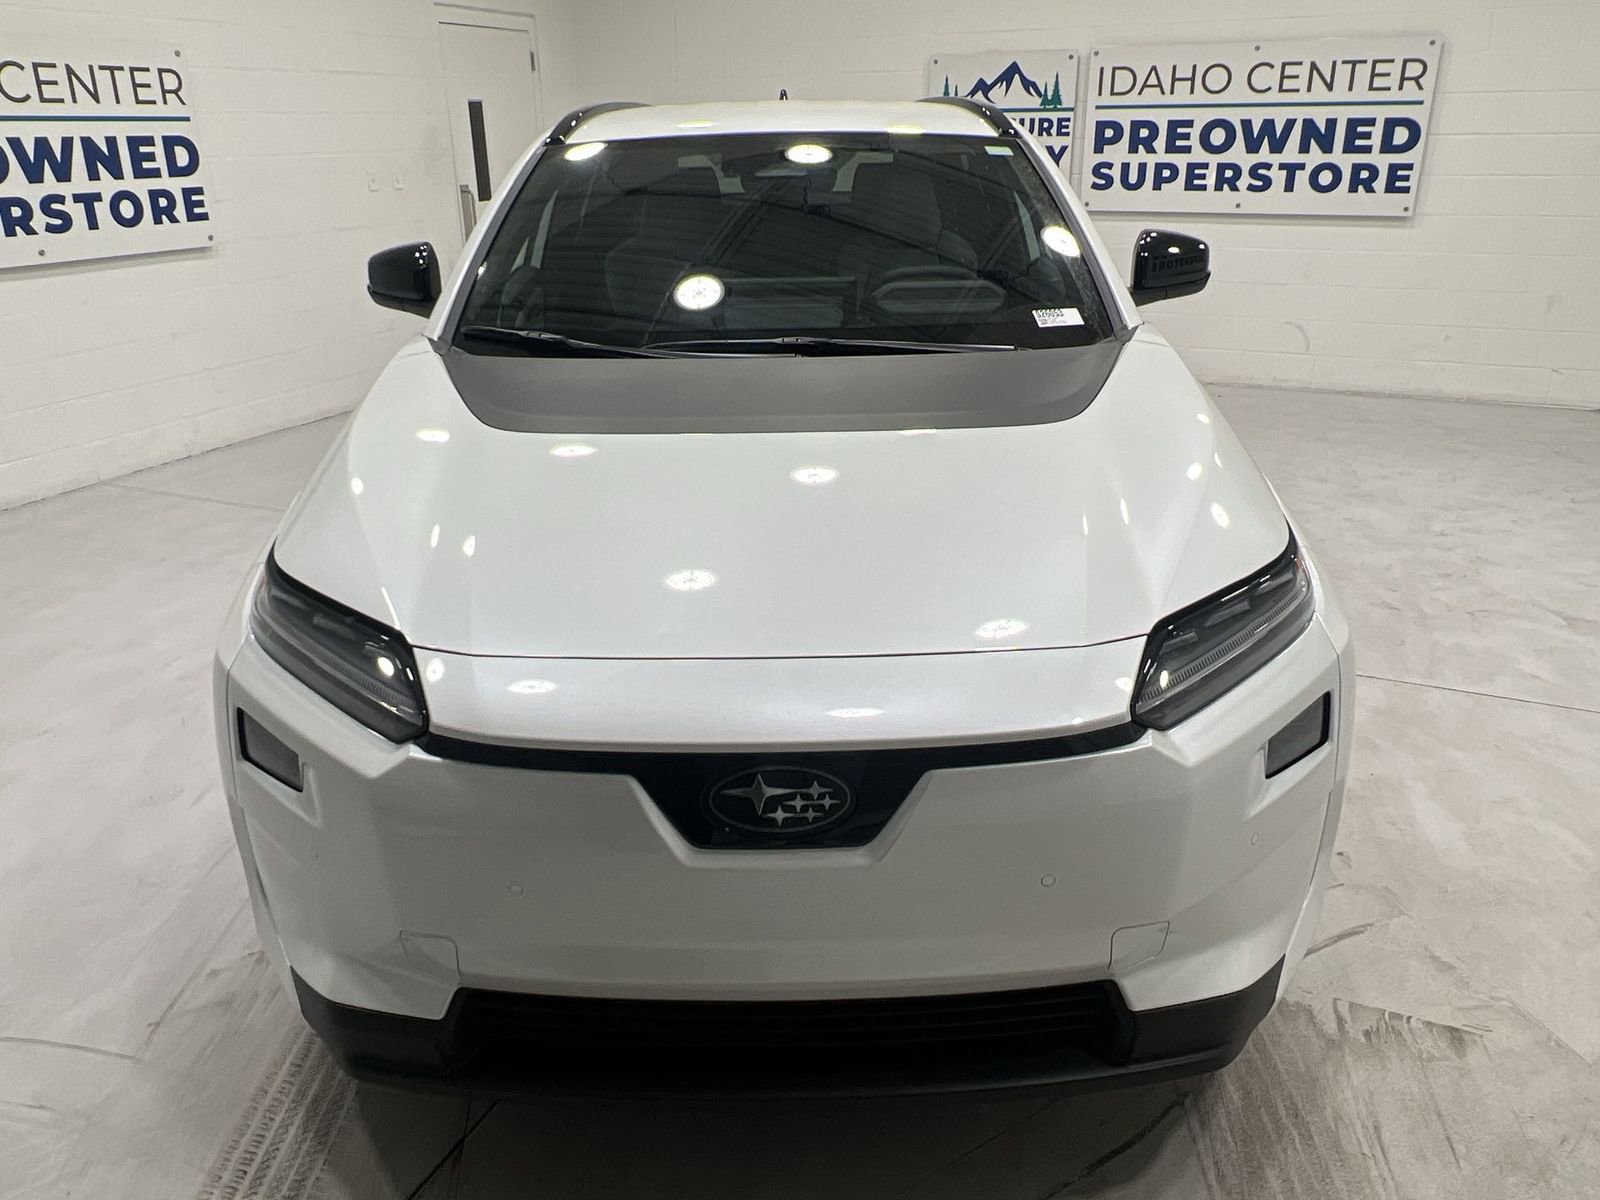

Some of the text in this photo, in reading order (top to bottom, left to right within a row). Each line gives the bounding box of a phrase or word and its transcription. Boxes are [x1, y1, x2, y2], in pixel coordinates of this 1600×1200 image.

[0, 60, 187, 106] CENTER
[1097, 58, 1429, 97] IDAHO CENTER
[1011, 117, 1071, 137] URE
[1093, 117, 1422, 155] PREOWNED
[0, 135, 200, 184] WNED
[1090, 161, 1415, 194] SUPERSTORE
